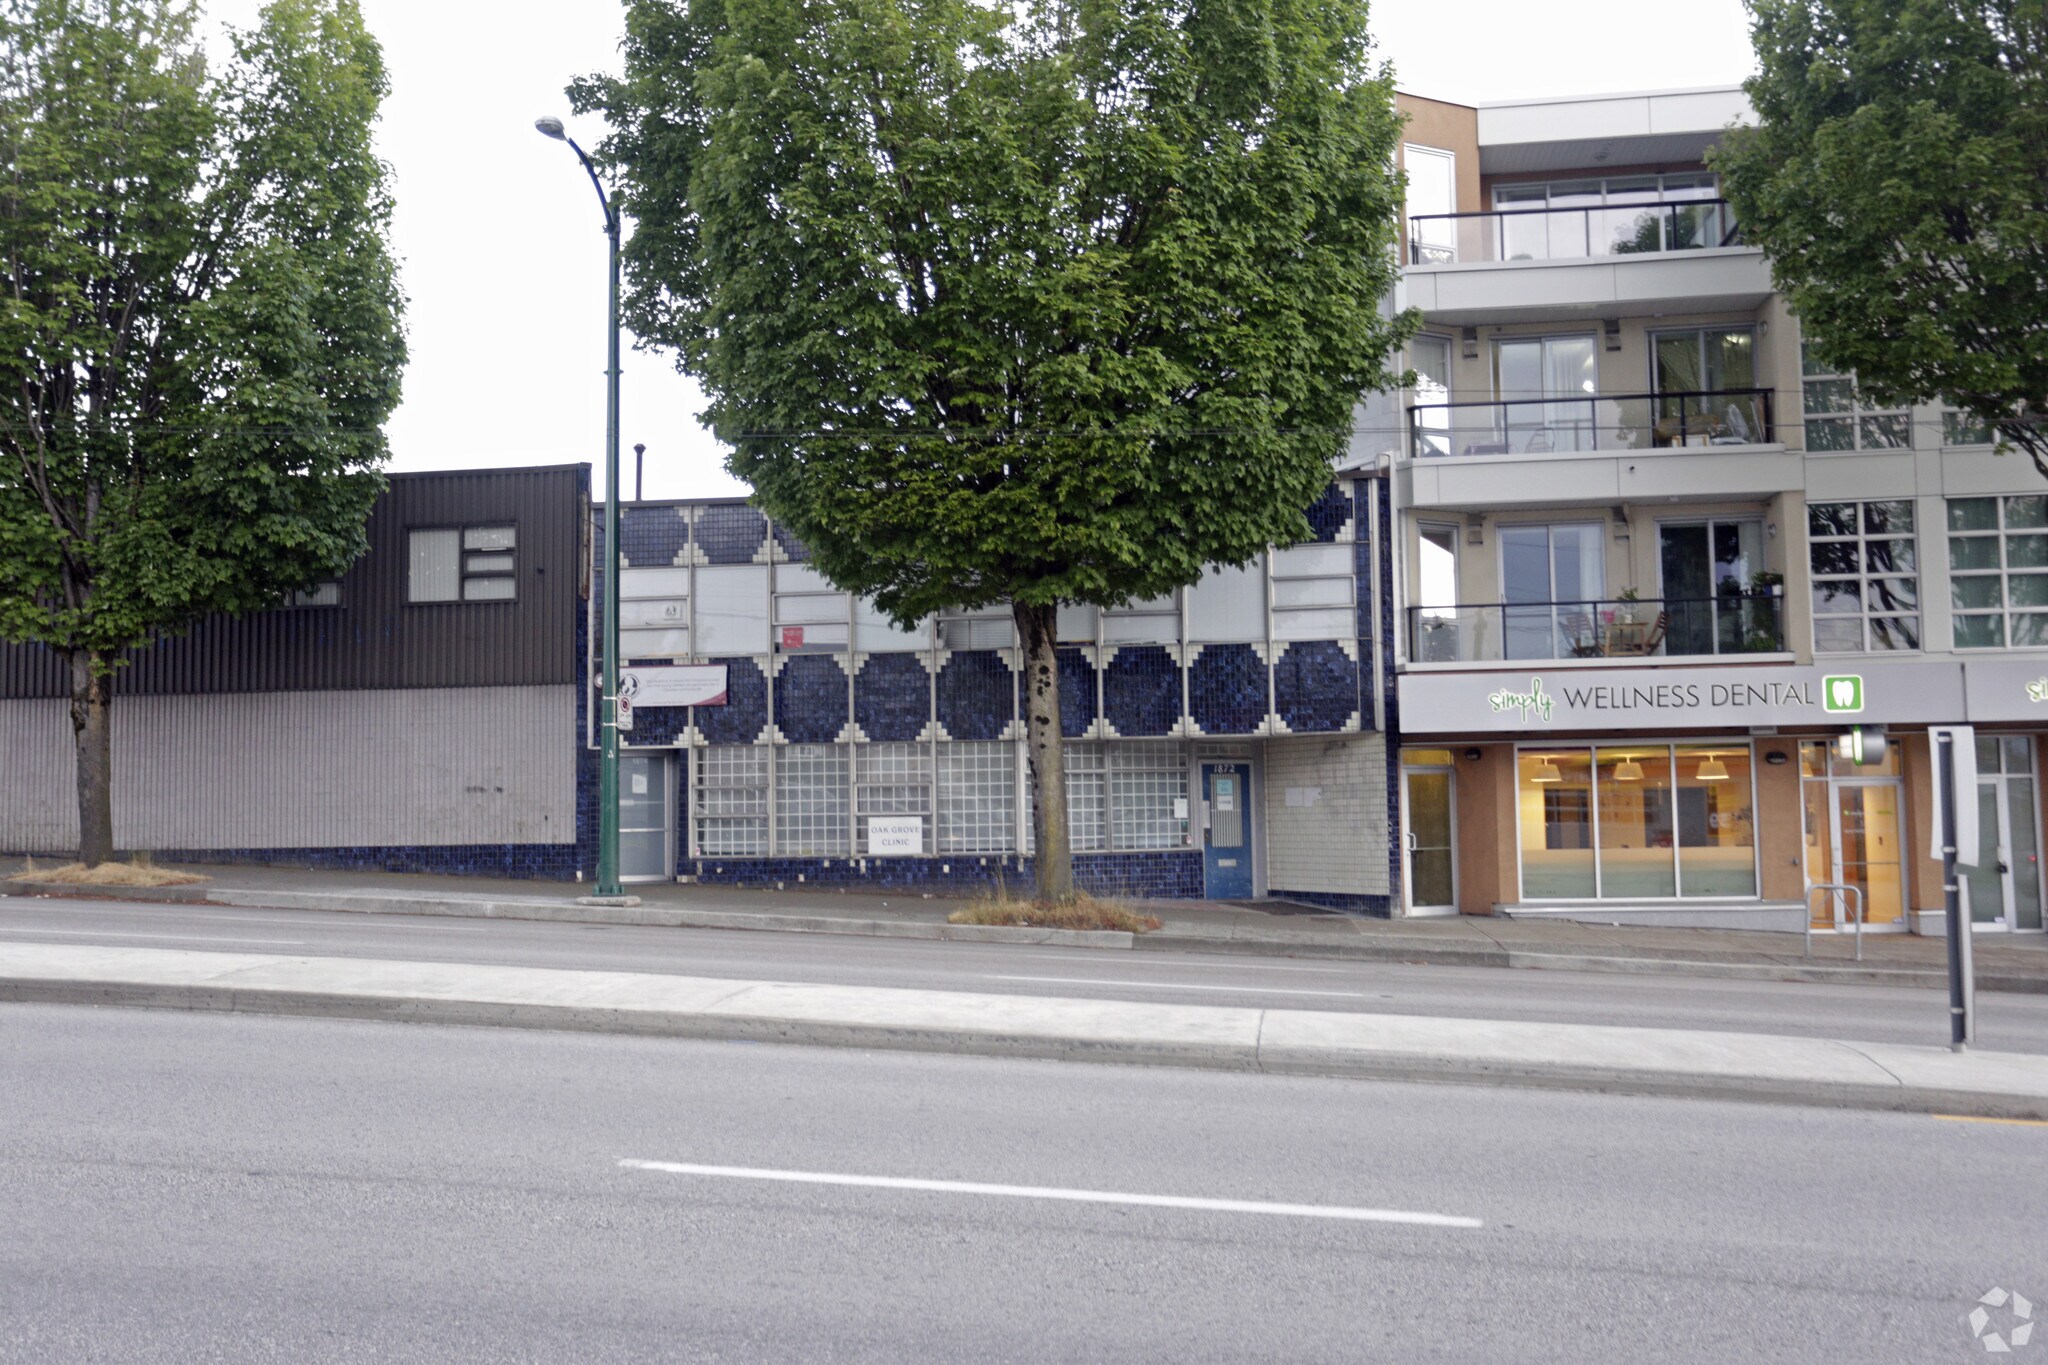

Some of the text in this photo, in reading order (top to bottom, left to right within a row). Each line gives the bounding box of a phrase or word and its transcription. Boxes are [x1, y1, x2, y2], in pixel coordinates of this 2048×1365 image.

[1488, 677, 1815, 722] simply WELLNESS DENTAL
[1213, 763, 1235, 773] 1872
[871, 825, 921, 834] OAK GROVE
[881, 838, 910, 847] CLINIC
